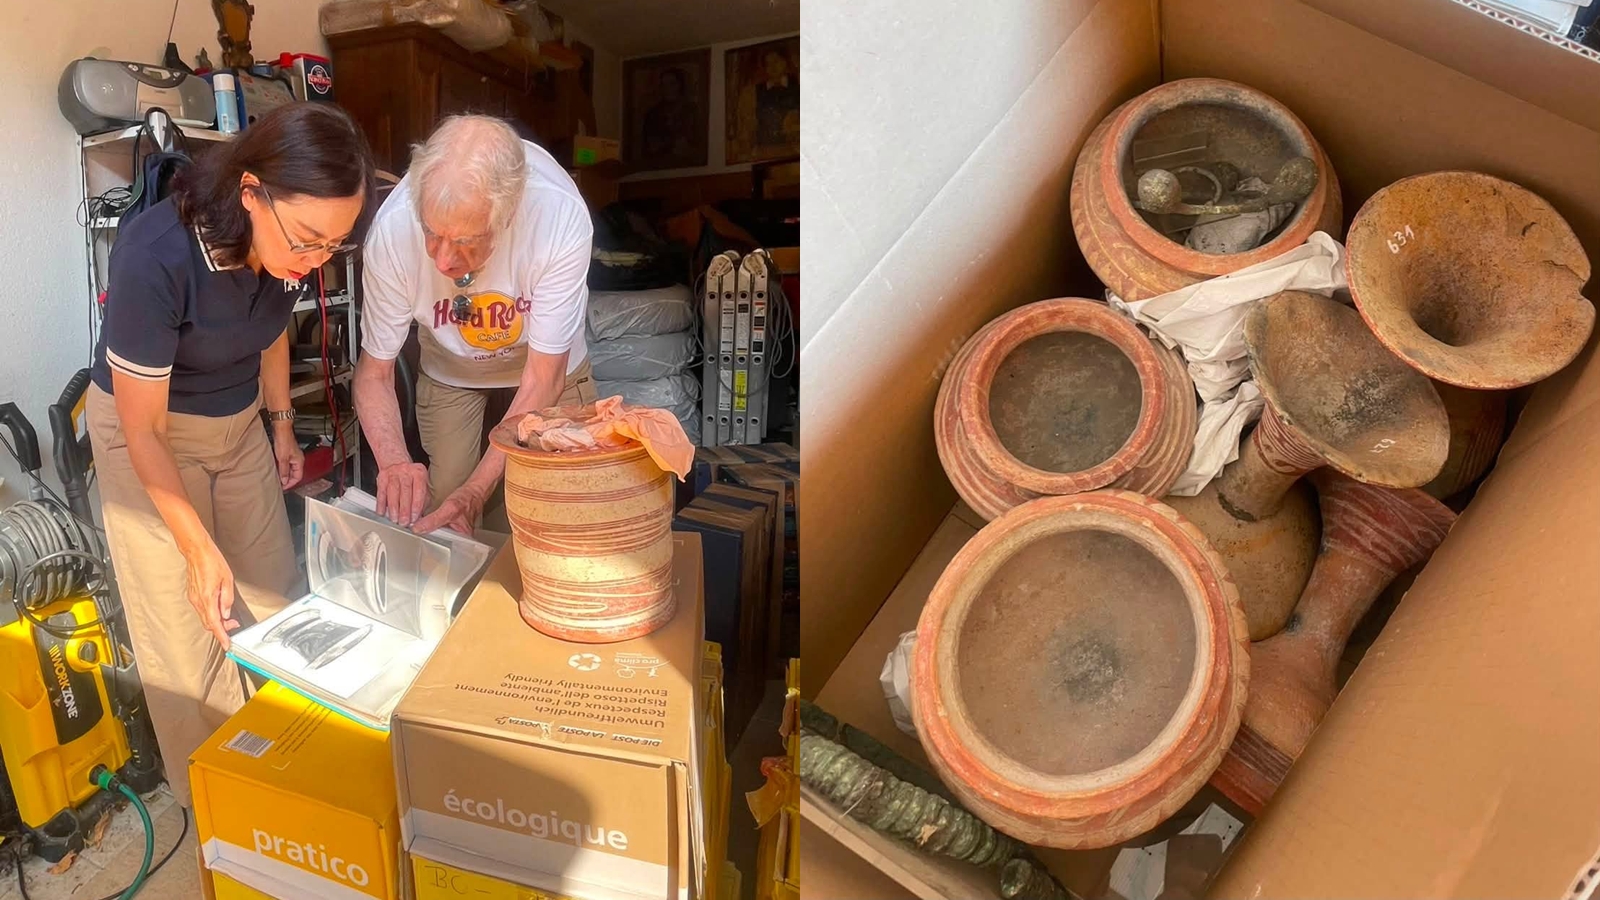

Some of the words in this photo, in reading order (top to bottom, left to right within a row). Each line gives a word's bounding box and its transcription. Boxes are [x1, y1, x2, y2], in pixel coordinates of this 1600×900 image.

[1387, 225, 1415, 254] 631
[477, 330, 511, 342] CAFE
[474, 353, 496, 361] NEW
[504, 673, 553, 686] friendly
[455, 683, 560, 706] l'environnement
[500, 682, 590, 699] dell'ambiente
[556, 680, 668, 697] Environmentally
[564, 700, 581, 708] de
[593, 693, 667, 707] Rispettoso
[535, 705, 665, 728] Umweltfreundlich
[585, 702, 666, 717] Respecteux
[558, 726, 591, 737] POSTE
[612, 735, 640, 744] POST
[641, 739, 660, 747] DIE
[443, 788, 629, 850] écologique
[252, 828, 369, 887] pratico
